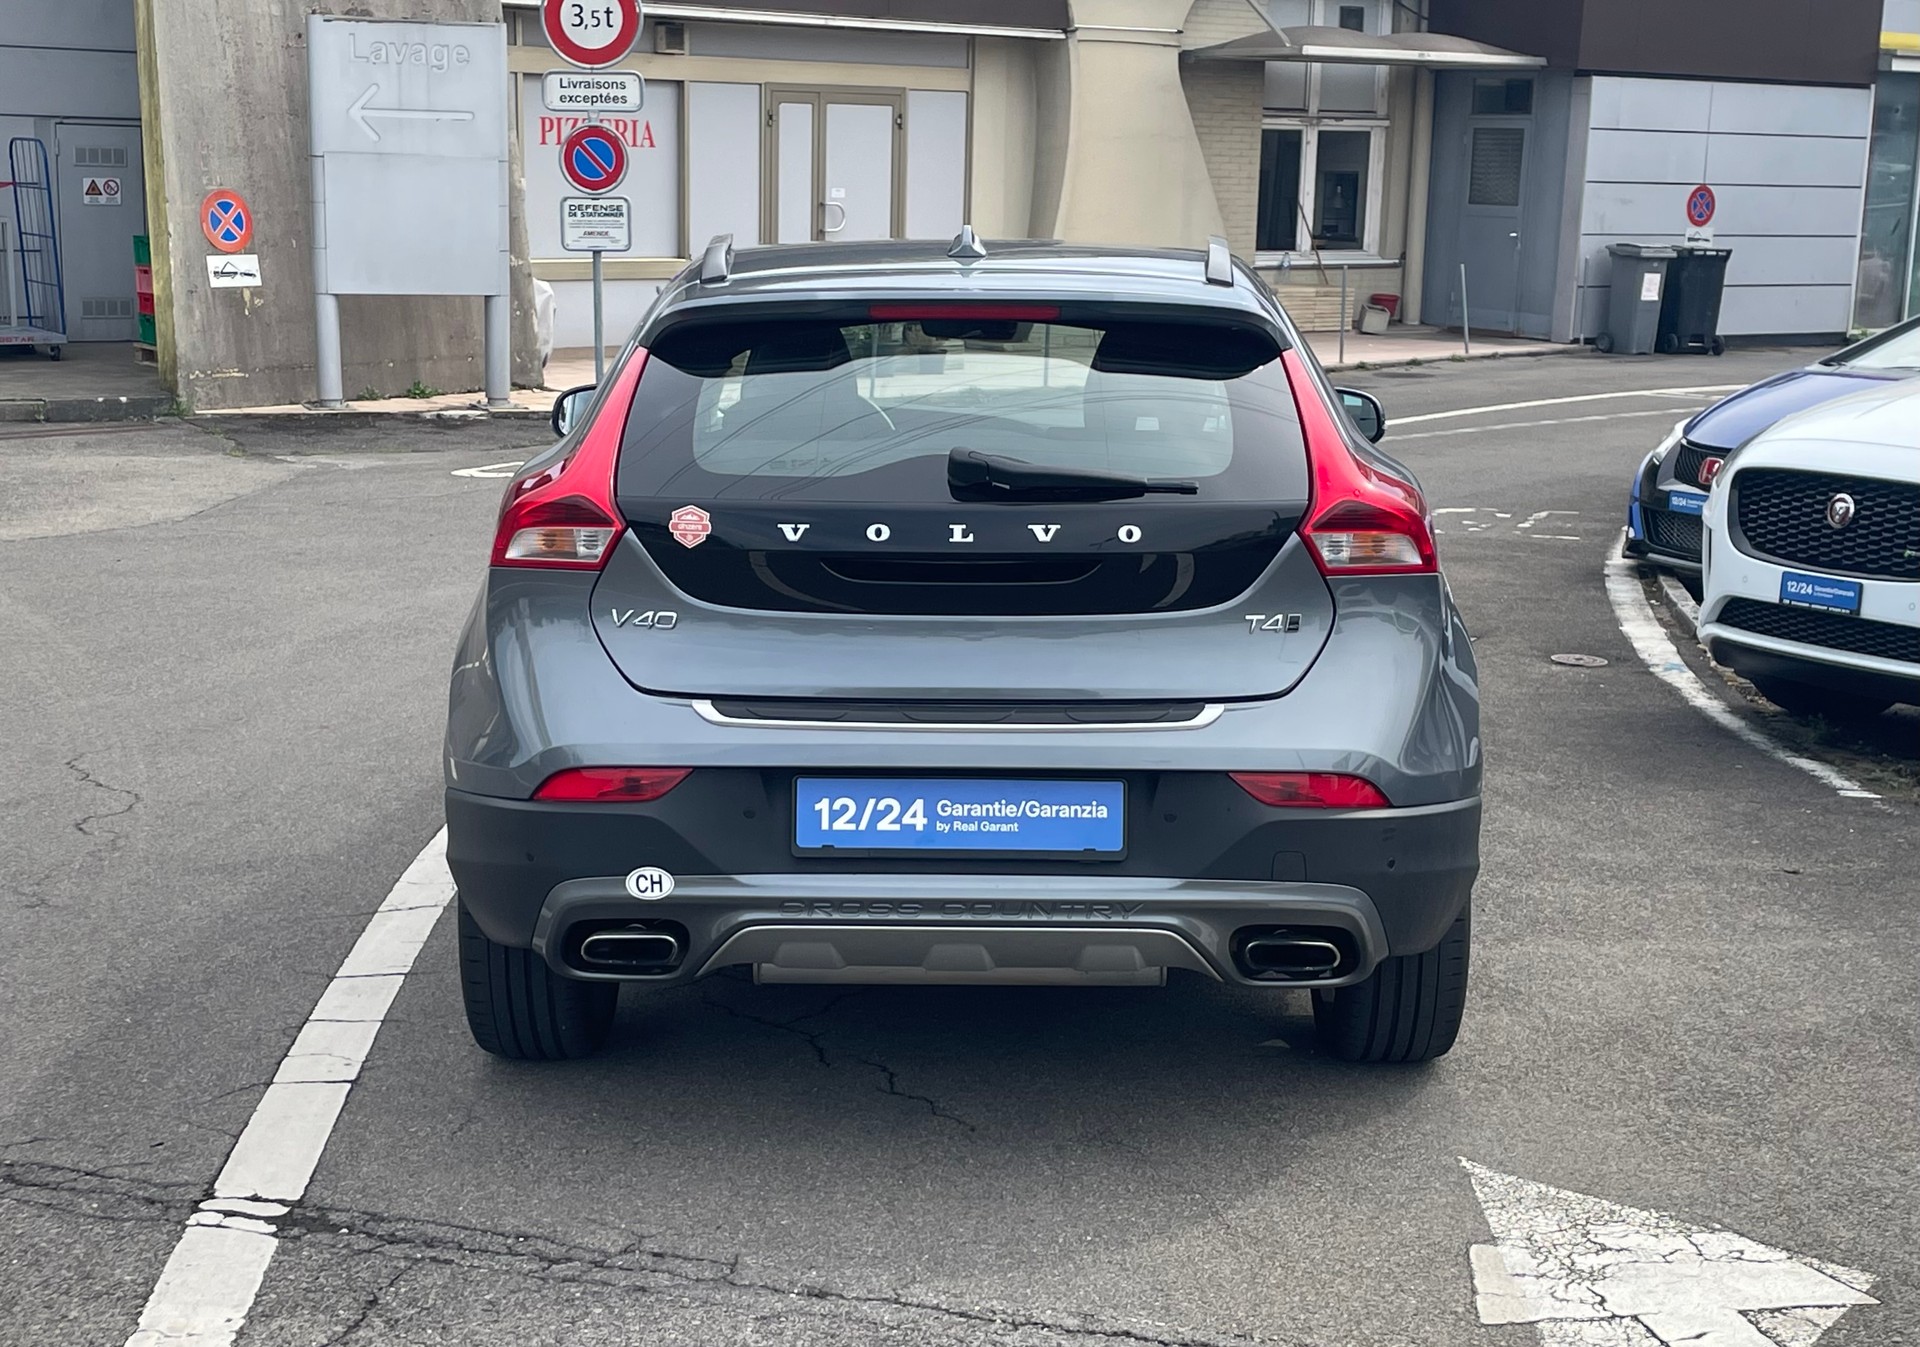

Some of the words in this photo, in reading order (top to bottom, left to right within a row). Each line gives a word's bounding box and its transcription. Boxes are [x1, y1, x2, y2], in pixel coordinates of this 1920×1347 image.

[348, 32, 471, 72] Lavage
[559, 78, 627, 90] Livraisons
[559, 93, 628, 106] exceptées
[539, 116, 656, 148] PIRIA
[777, 523, 1143, 543] VOLVO
[1787, 581, 1813, 596] 12/24
[611, 608, 678, 629] V40
[814, 797, 928, 832] 12/24
[935, 799, 1108, 819] Garantie/Garanzia
[935, 820, 951, 833] by
[953, 821, 978, 832] Real
[980, 821, 1019, 833] Garant
[636, 873, 663, 893] CH
[779, 900, 924, 918] CROSS
[939, 902, 1146, 921] COUNTRY
